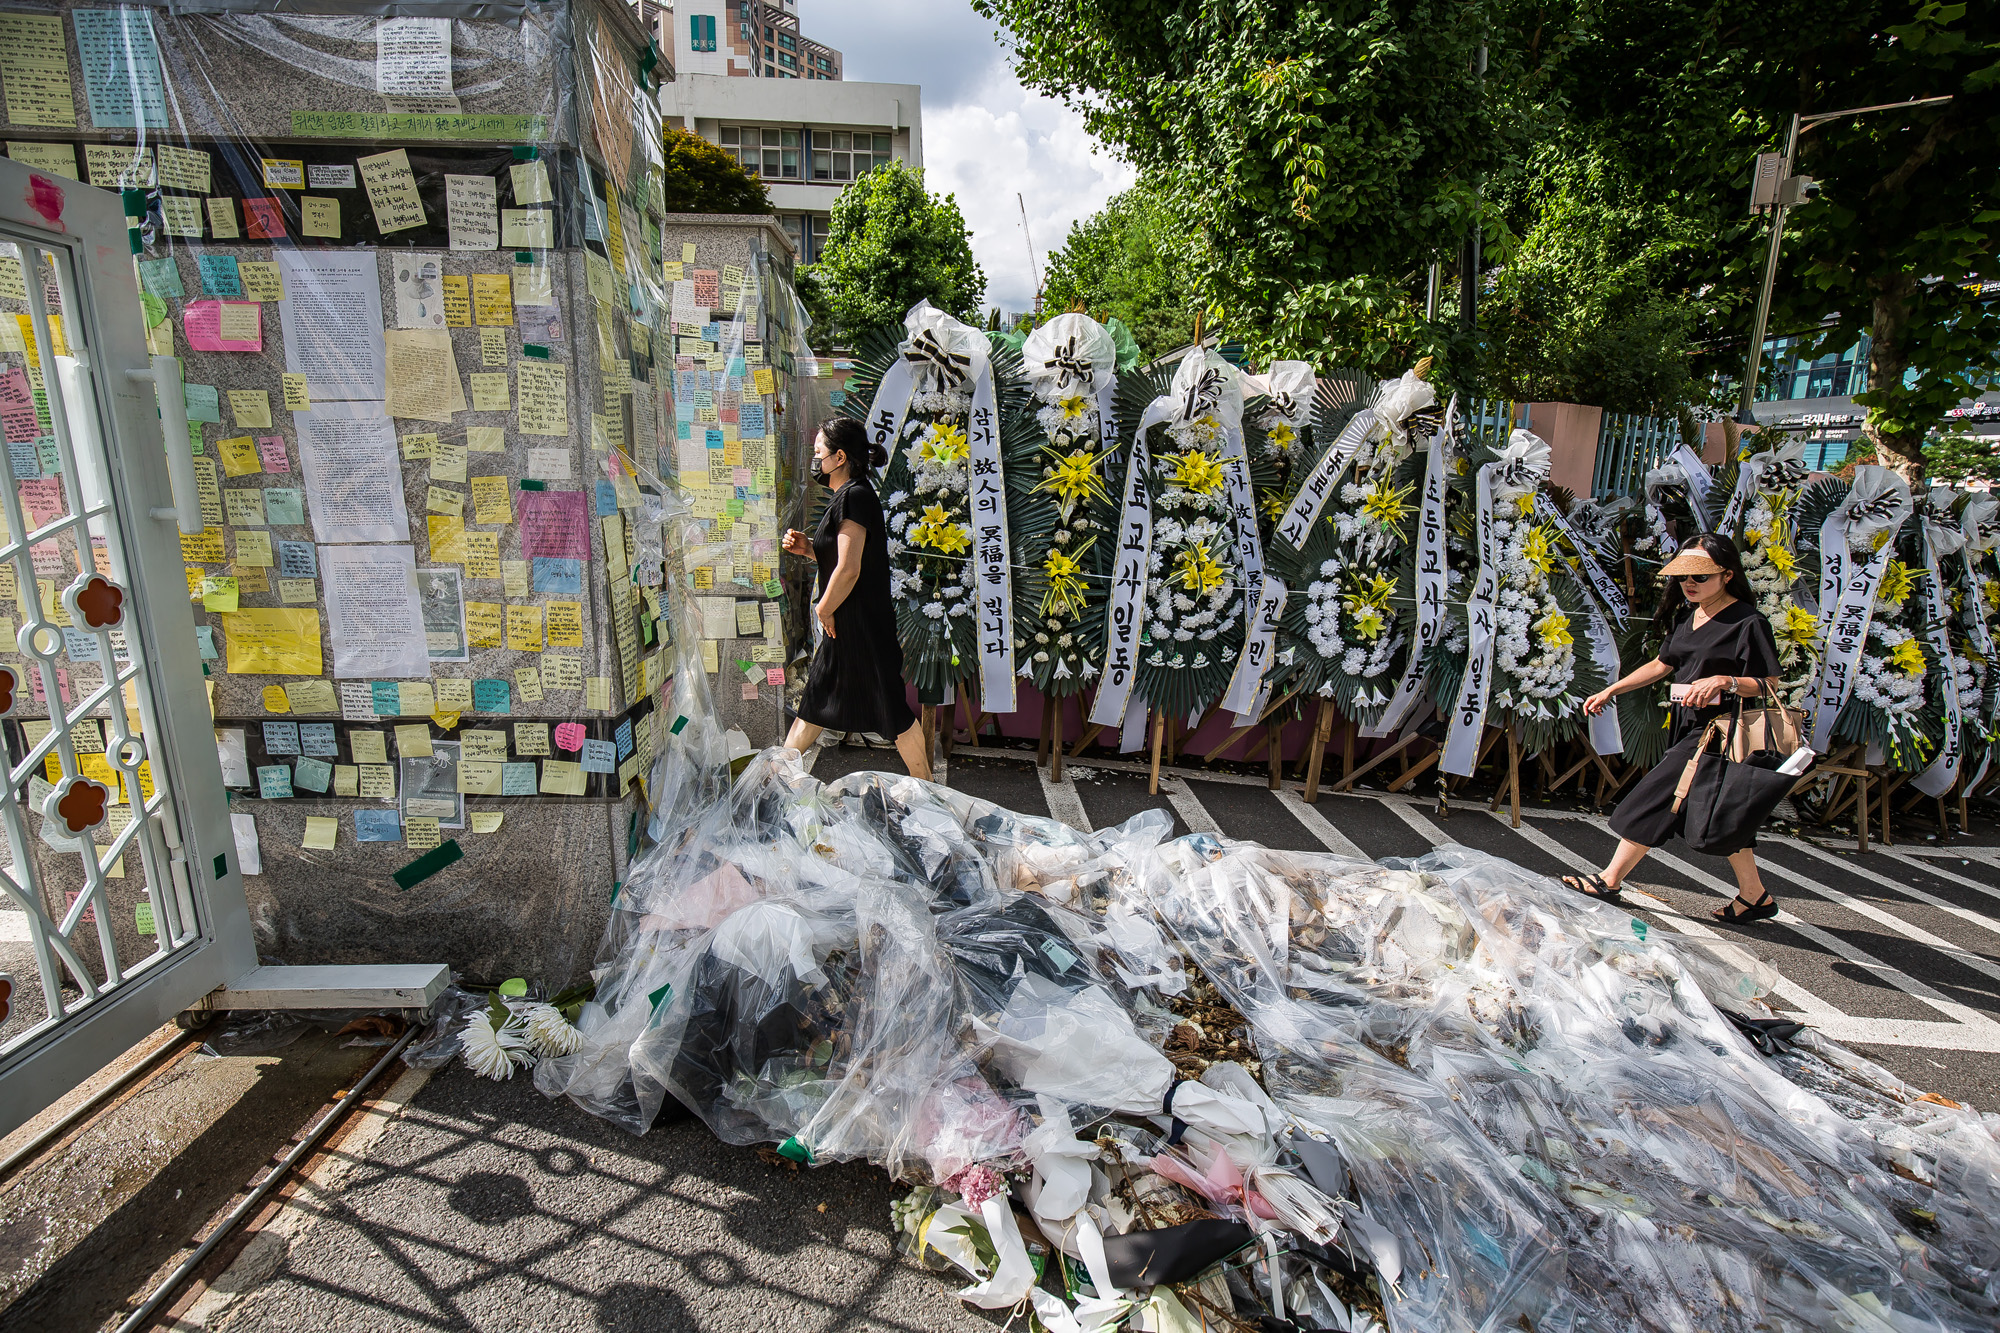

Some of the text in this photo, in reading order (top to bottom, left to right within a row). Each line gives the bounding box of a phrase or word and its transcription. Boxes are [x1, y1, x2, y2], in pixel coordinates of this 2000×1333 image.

[1802, 412, 1831, 427] 단지내
[973, 407, 1009, 660] 삼가 故人의 冥福을 빕니다
[1236, 504, 1255, 560] 故人의
[1823, 553, 1842, 598] 경기
[1833, 604, 1867, 654] 冥福을
[1823, 662, 1848, 712] 빕니다
